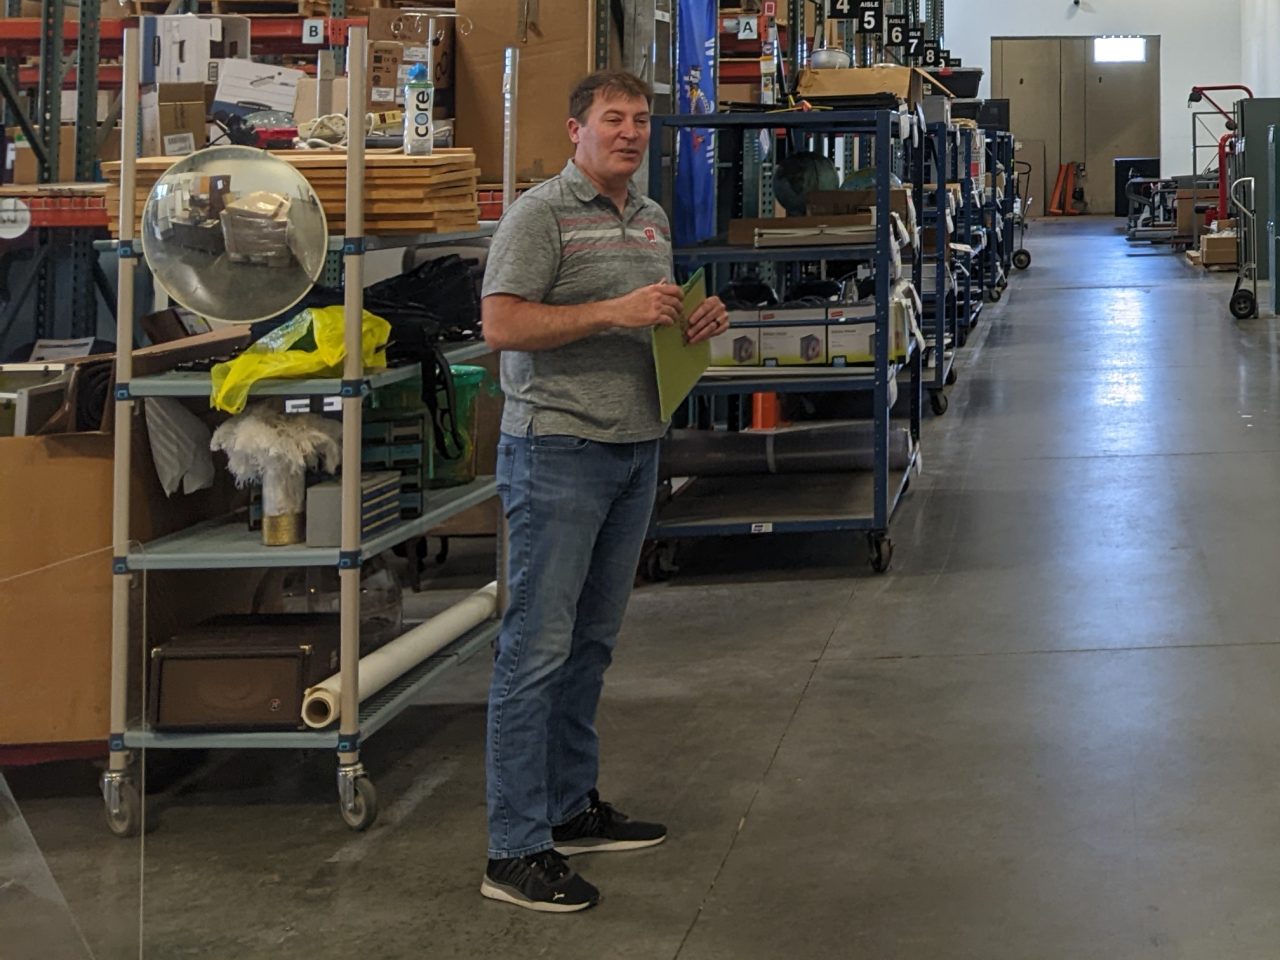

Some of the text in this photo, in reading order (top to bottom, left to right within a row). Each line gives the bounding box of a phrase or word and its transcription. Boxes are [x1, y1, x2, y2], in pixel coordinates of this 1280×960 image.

[742, 21, 753, 33] A
[863, 11, 876, 30] 5
[309, 25, 318, 38] B
[891, 27, 902, 43] 6
[908, 39, 918, 54] 7
[926, 49, 935, 63] 8
[415, 90, 430, 138] core
